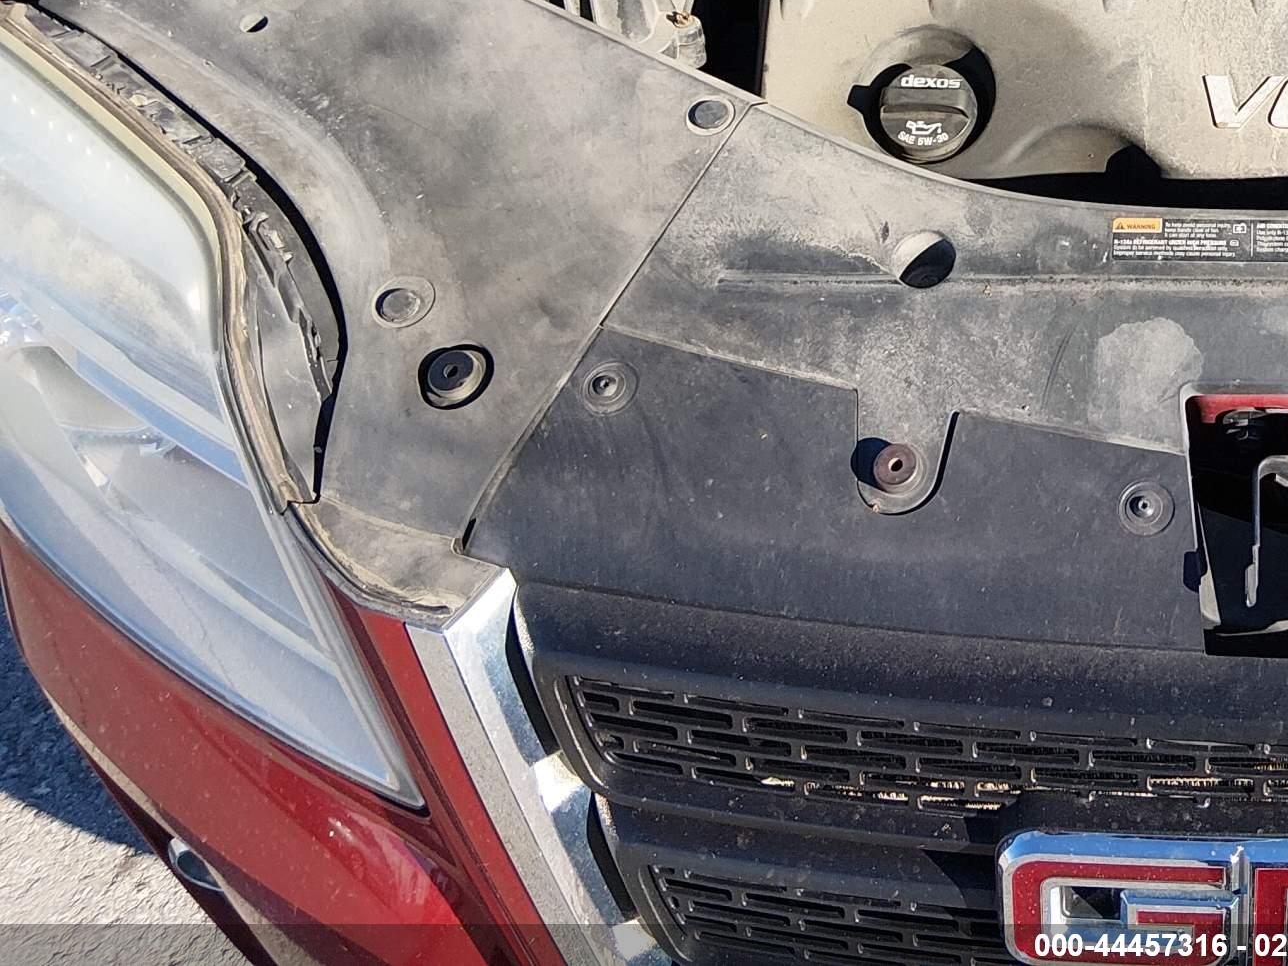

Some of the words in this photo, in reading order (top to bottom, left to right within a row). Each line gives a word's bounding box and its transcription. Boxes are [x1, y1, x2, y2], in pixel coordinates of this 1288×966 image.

[901, 75, 963, 88] dexos
[898, 131, 916, 144] SAE
[917, 132, 949, 145] 5W-30
